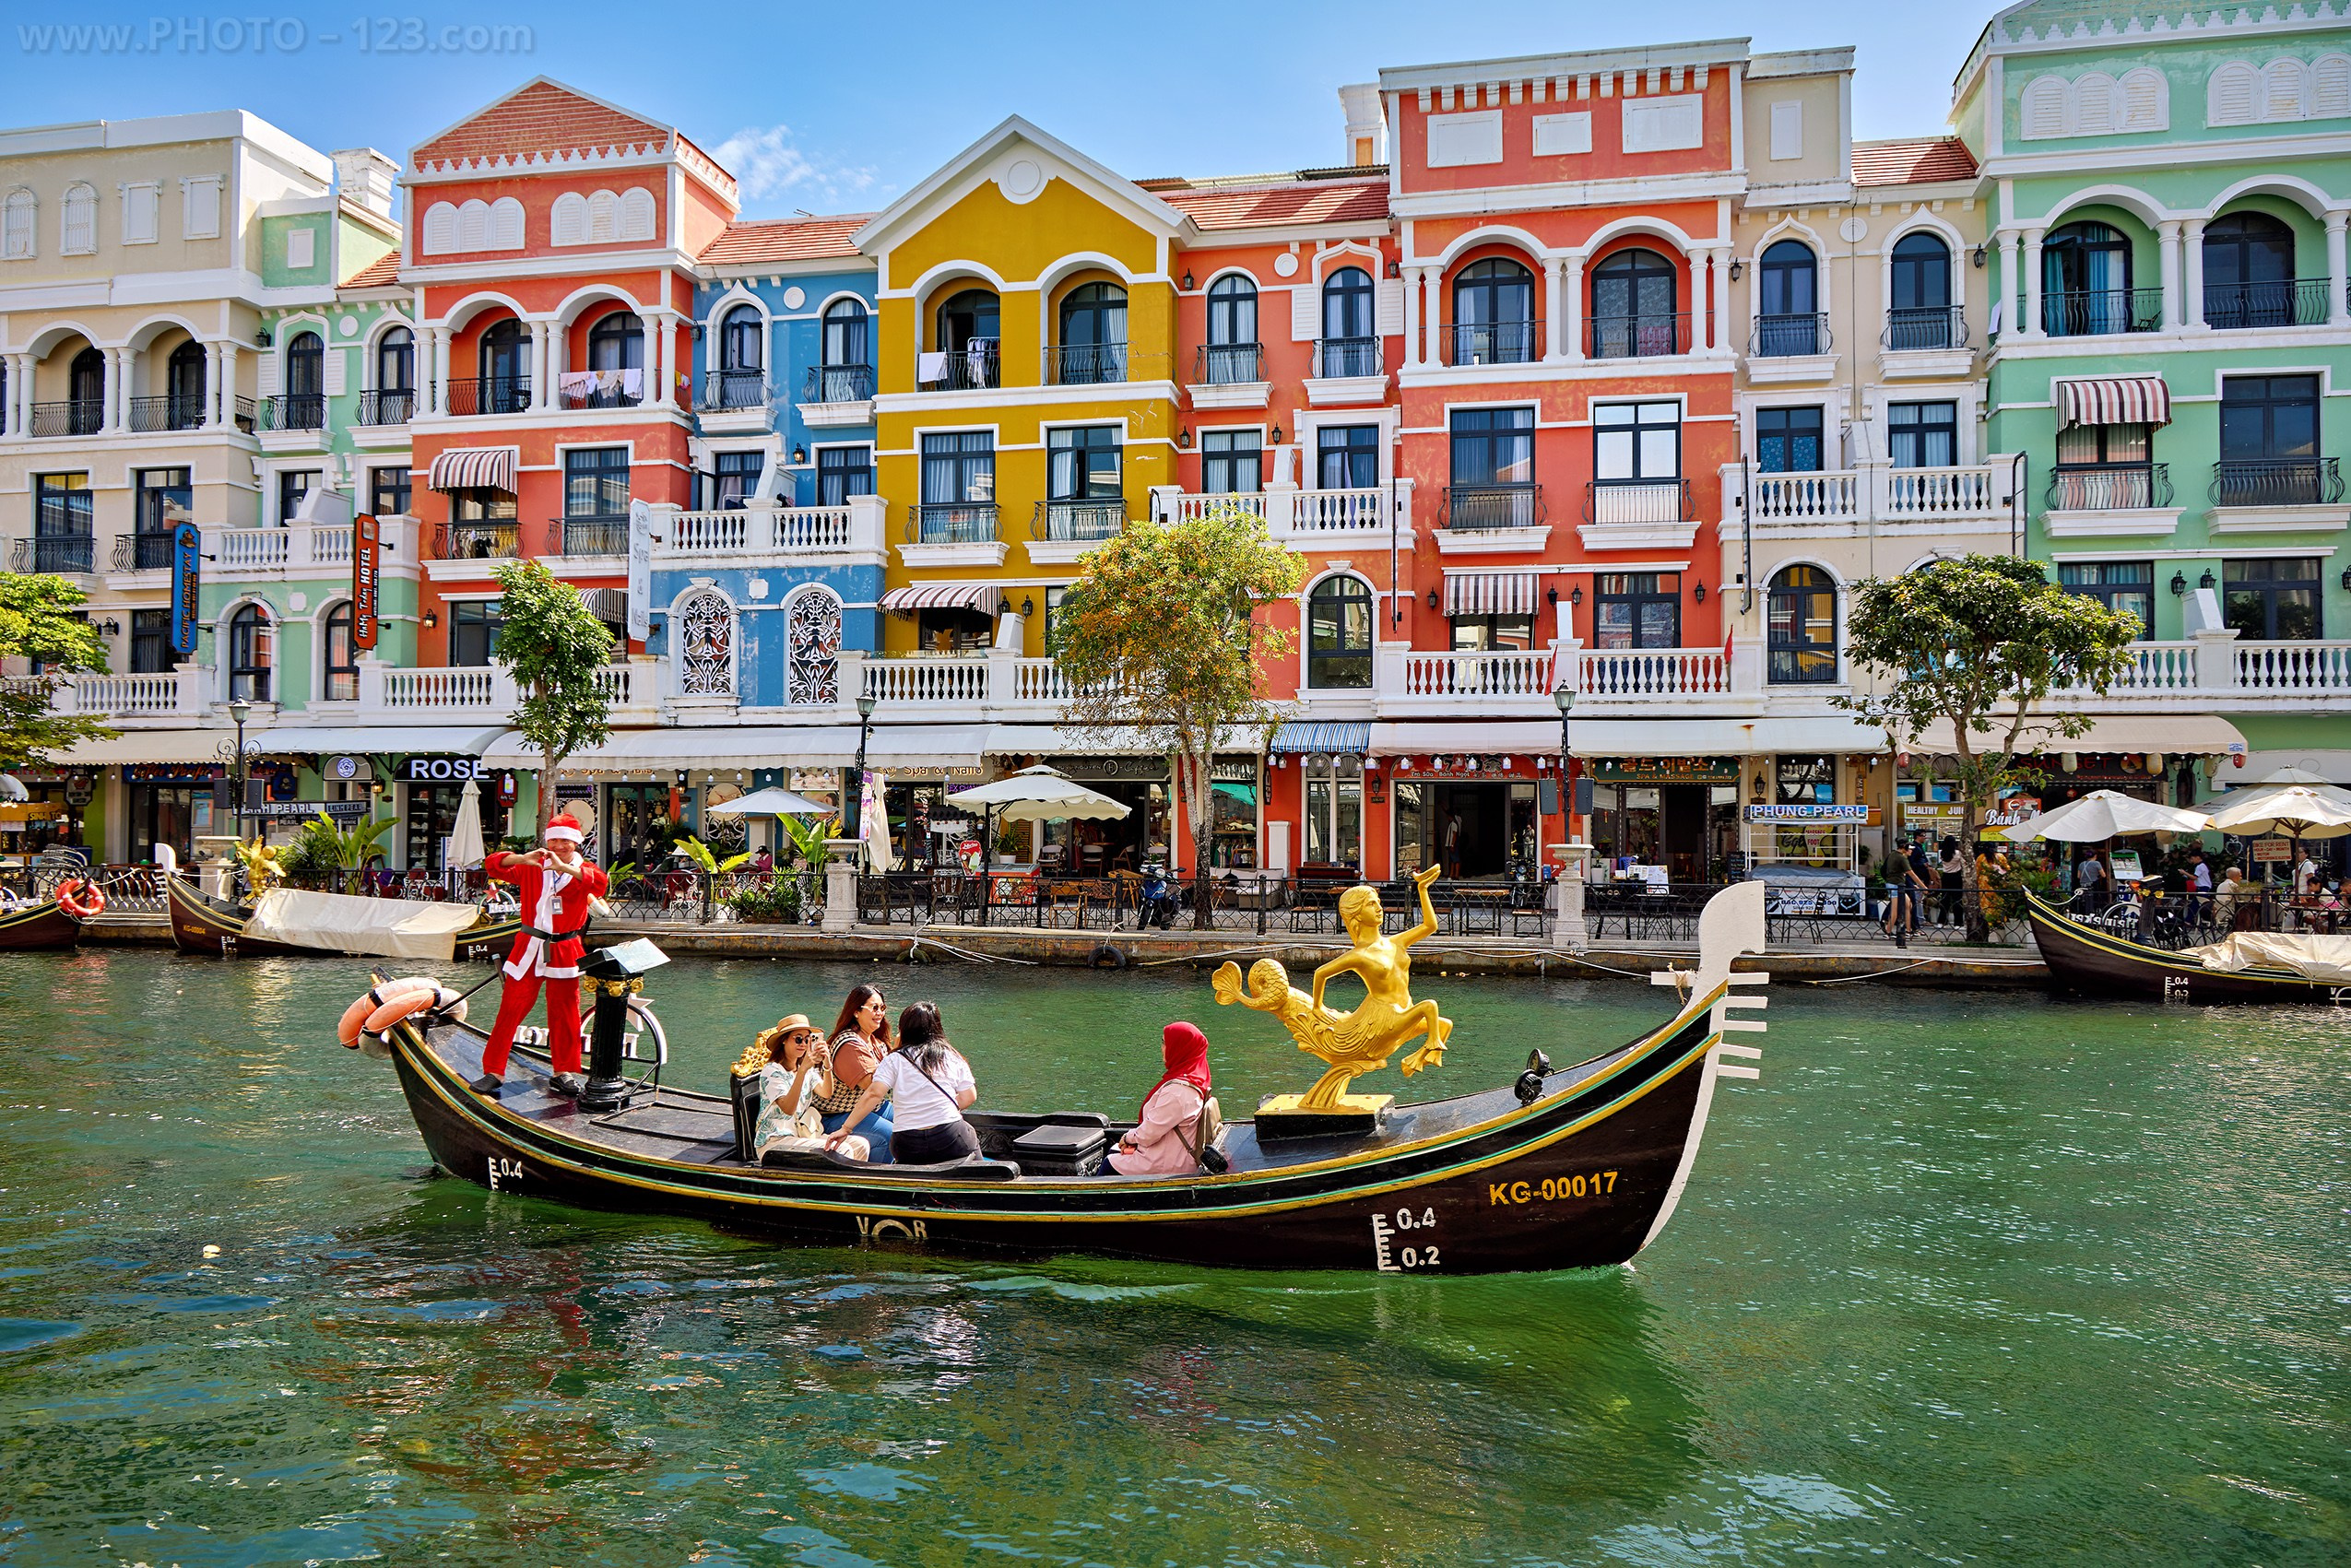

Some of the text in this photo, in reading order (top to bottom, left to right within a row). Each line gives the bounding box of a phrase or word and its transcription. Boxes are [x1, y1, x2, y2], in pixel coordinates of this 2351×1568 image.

[360, 548, 371, 584] HOTEL
[181, 552, 192, 648] PACIFIC HOMESTAY
[359, 587, 372, 610] Today
[410, 760, 490, 779] ROSE
[1661, 758, 1709, 772] 이발소
[30, 812, 46, 820] SINH
[277, 804, 312, 814] PEARL
[1813, 806, 1865, 817] PEARL
[1907, 806, 1939, 815] HEALTHY
[1984, 808, 2022, 826] Bánh
[1807, 838, 1820, 846] FOOT
[226, 936, 236, 944] 0.4
[2174, 976, 2189, 985] 0.4
[501, 1158, 523, 1179] 0.4
[1489, 1171, 1619, 1206] KG-00017
[1396, 1207, 1436, 1230] 0.4
[1401, 1246, 1440, 1267] 0.2
